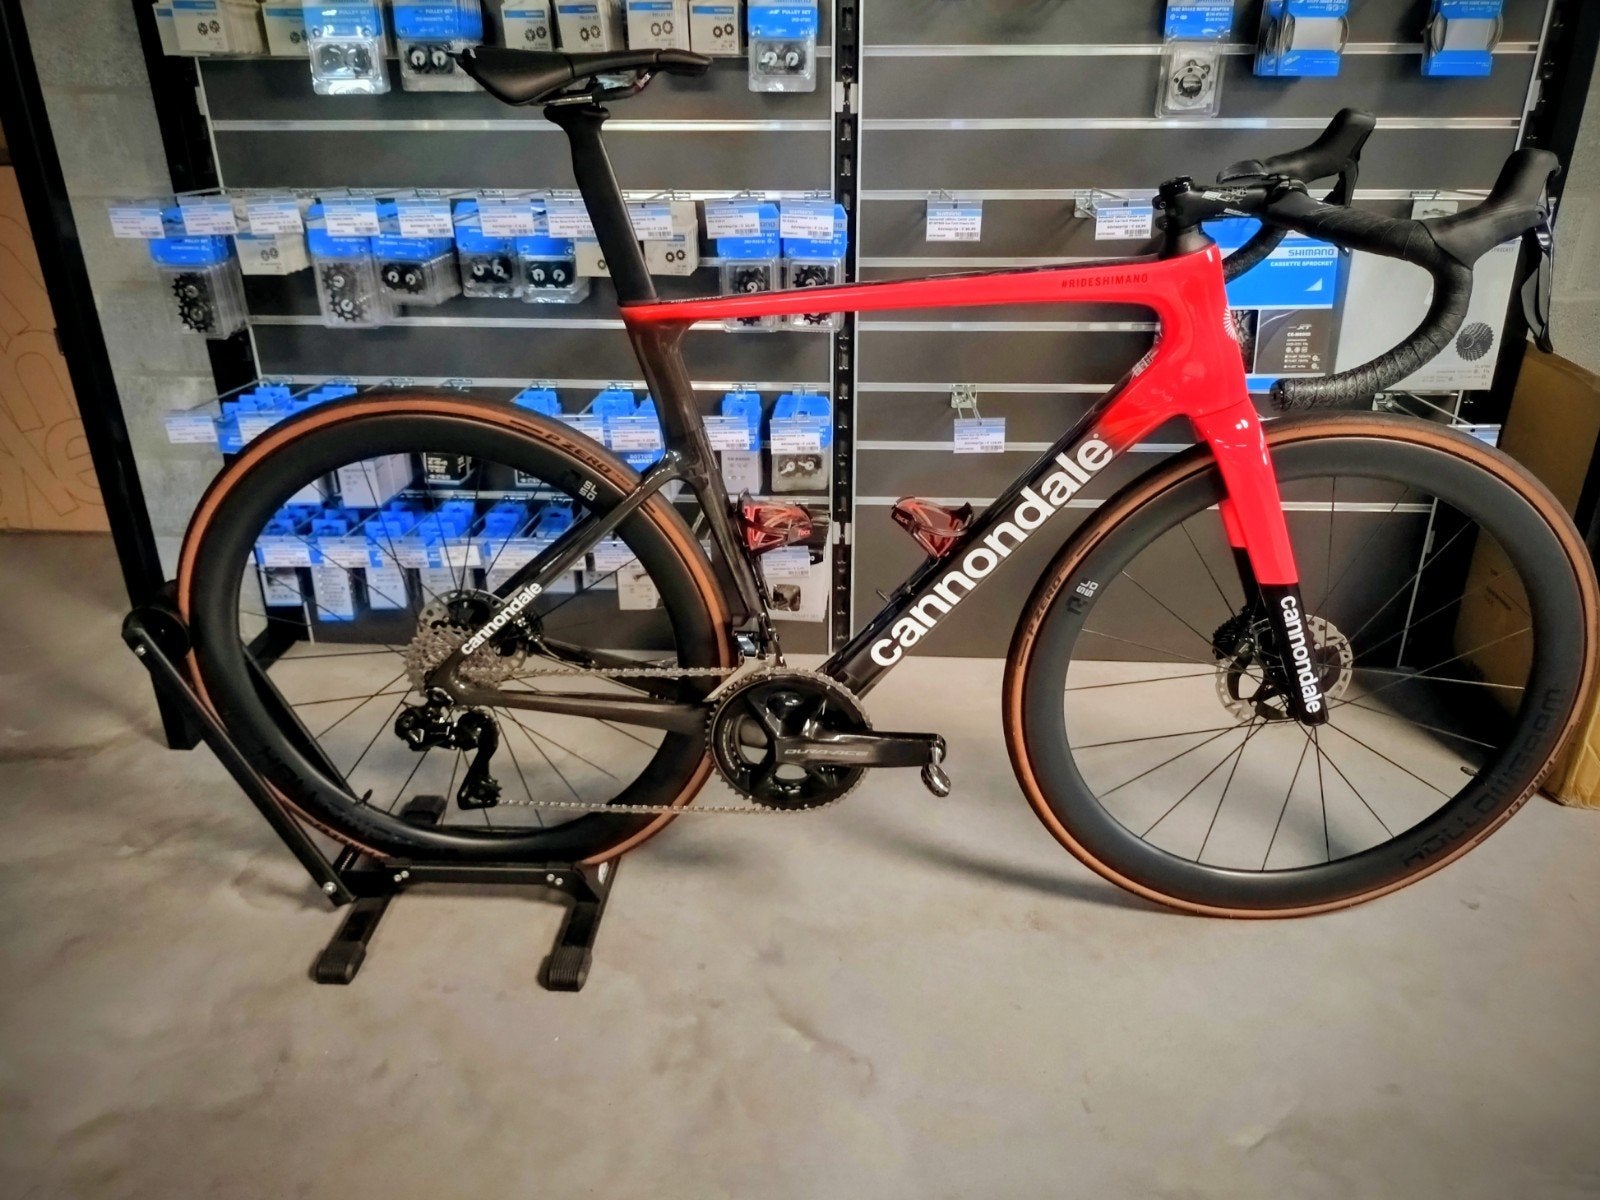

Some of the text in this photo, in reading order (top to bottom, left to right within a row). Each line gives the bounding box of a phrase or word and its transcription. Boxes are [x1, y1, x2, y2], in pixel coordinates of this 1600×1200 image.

[1288, 248, 1335, 256] SHIMANO
[1061, 273, 1149, 288] #RIDESHIMANO
[543, 433, 561, 442] P
[561, 440, 612, 475] ZERO
[583, 480, 598, 496] SL
[870, 438, 1113, 667] cannondale
[1076, 580, 1091, 594] SL
[461, 582, 543, 655] cannondale
[1280, 595, 1322, 713] cannondale
